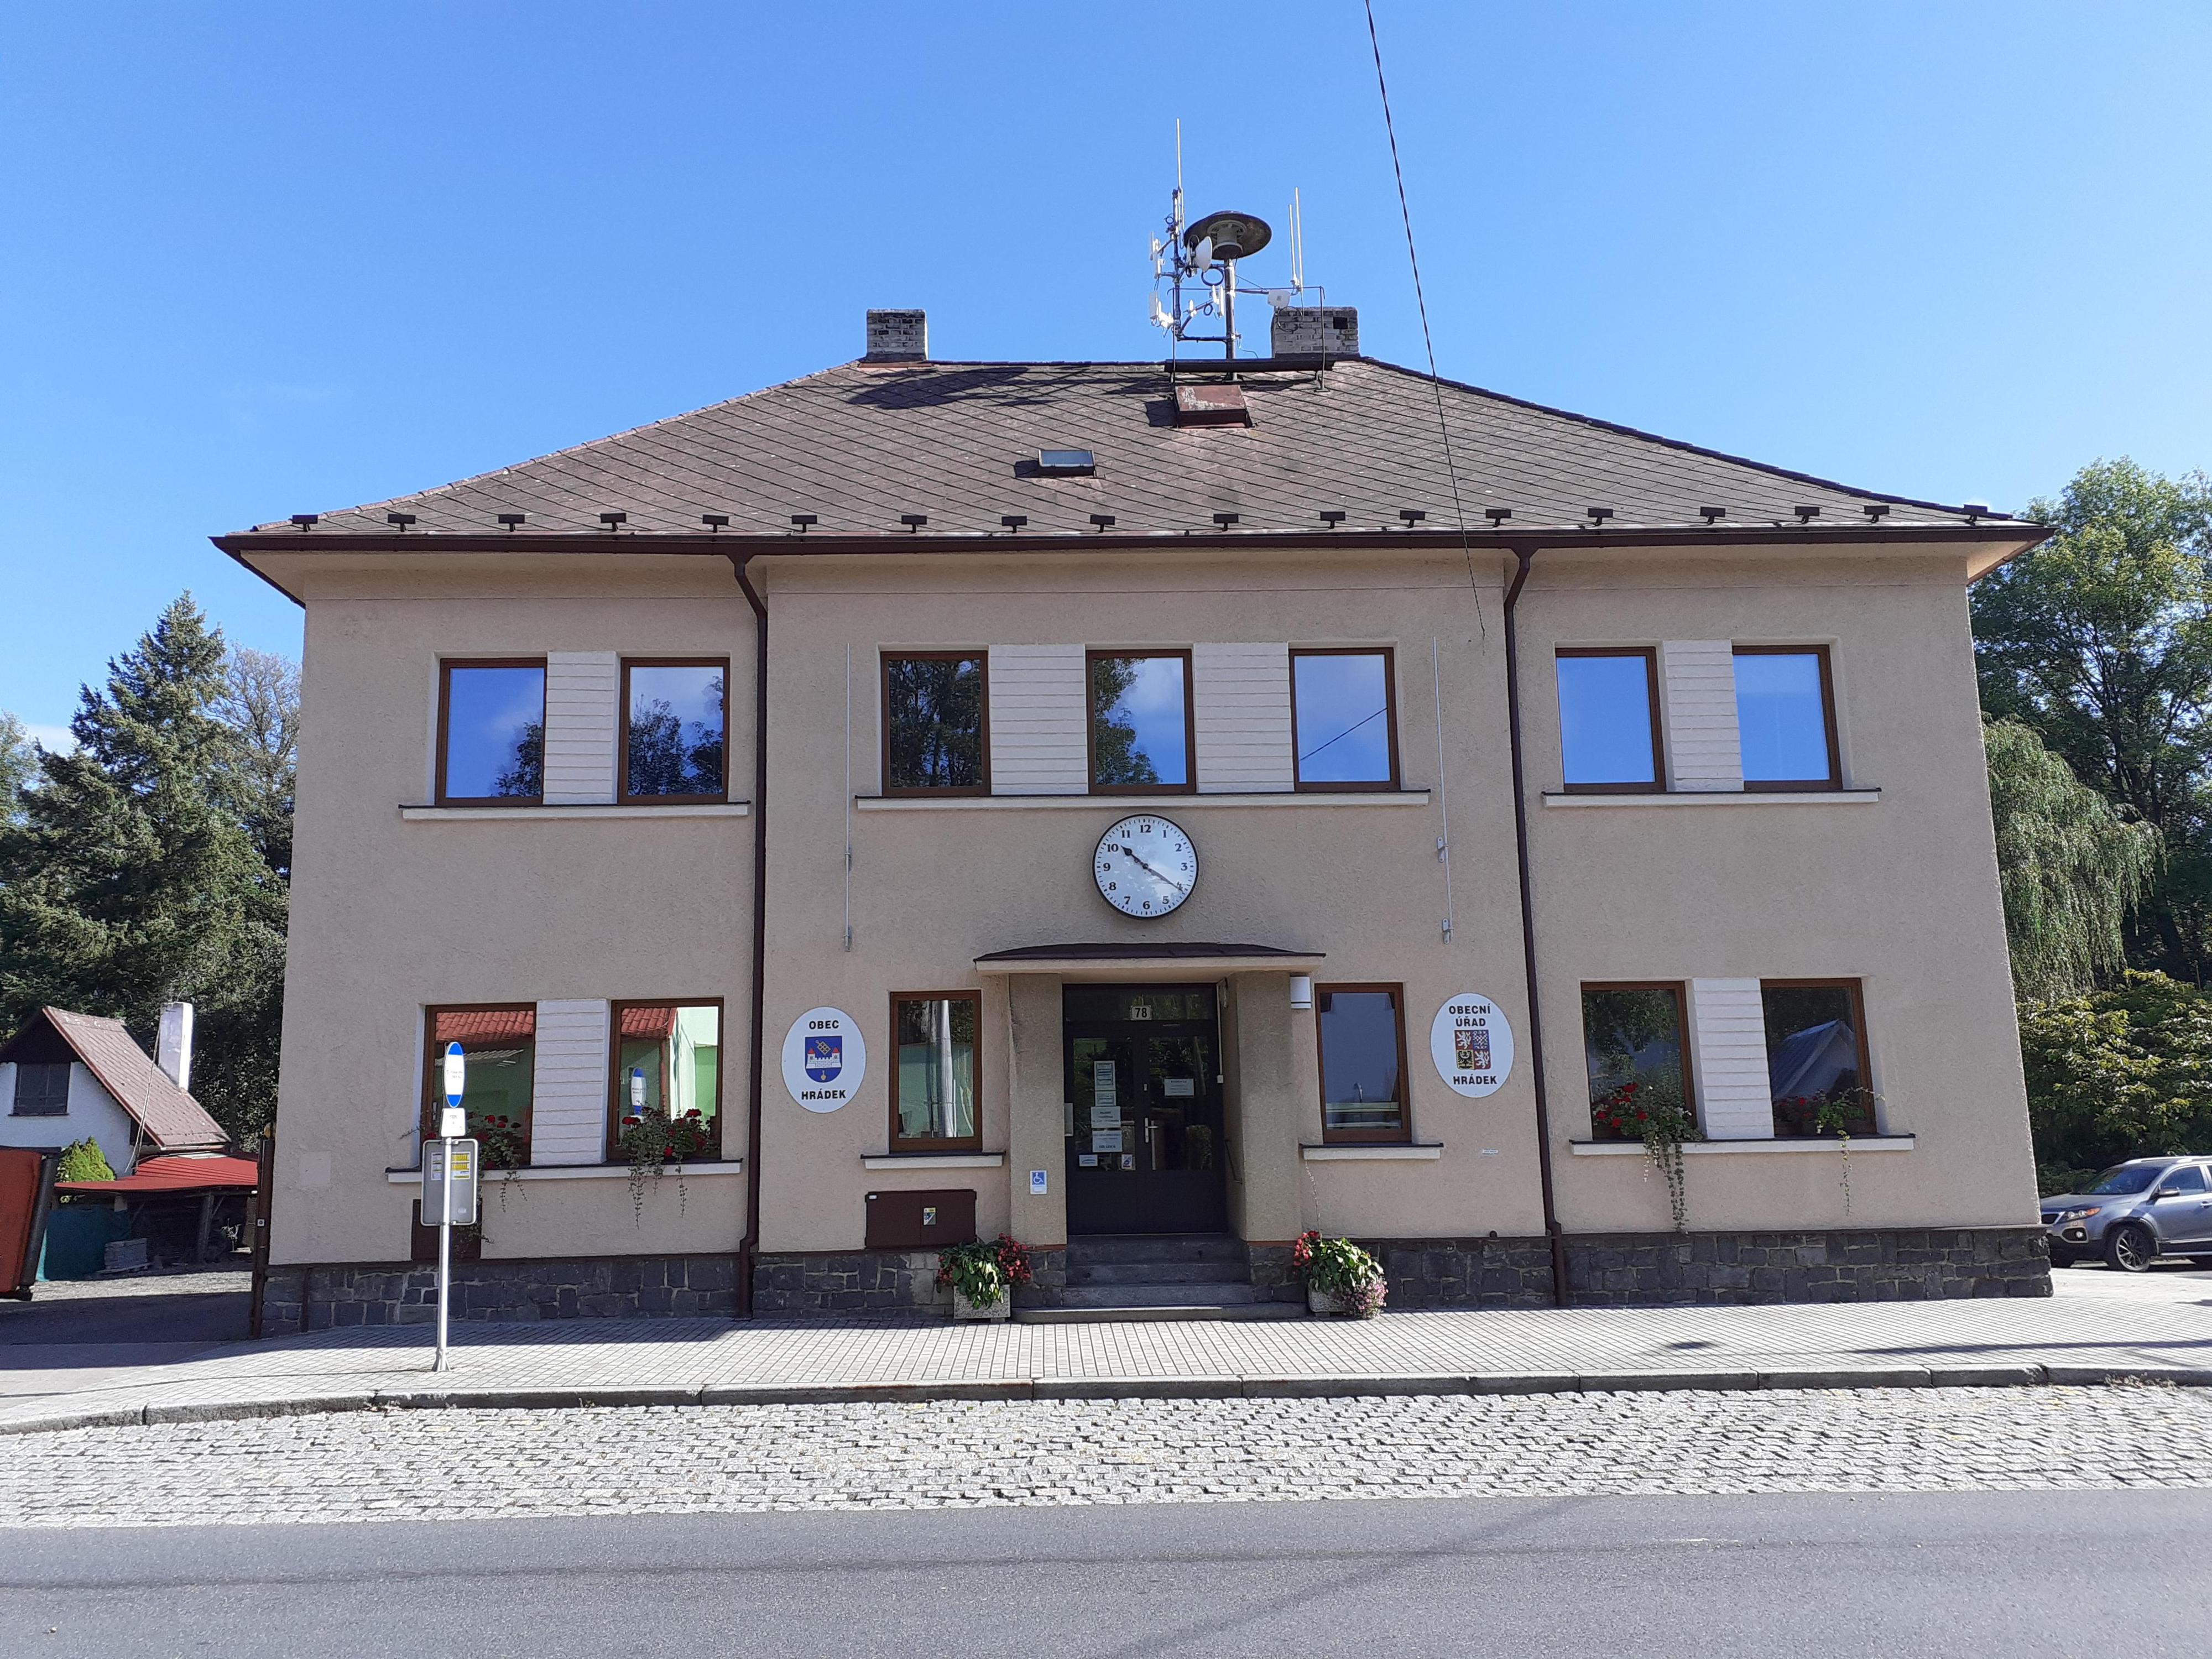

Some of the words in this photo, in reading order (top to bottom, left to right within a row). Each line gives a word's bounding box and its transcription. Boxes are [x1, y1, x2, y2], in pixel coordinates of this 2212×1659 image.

[1140, 825, 1151, 833] 12
[1121, 830, 1131, 838] 11
[1162, 830, 1167, 838] 1
[1107, 844, 1119, 852] 10
[1175, 843, 1182, 852] 2
[1103, 863, 1111, 872] 9
[1180, 862, 1188, 871] 3
[1109, 882, 1117, 891] 8
[1124, 896, 1131, 905] 7
[1162, 896, 1170, 905] 5
[1142, 901, 1151, 910] 6
[1135, 1008, 1147, 1018] 78
[1448, 1003, 1491, 1014] OBECNÍ
[808, 1020, 839, 1030] OBEC
[1455, 1016, 1486, 1027] ÚŘAD
[1453, 1073, 1498, 1085] HRÁDEK
[801, 1088, 847, 1100] HRÁDEK
